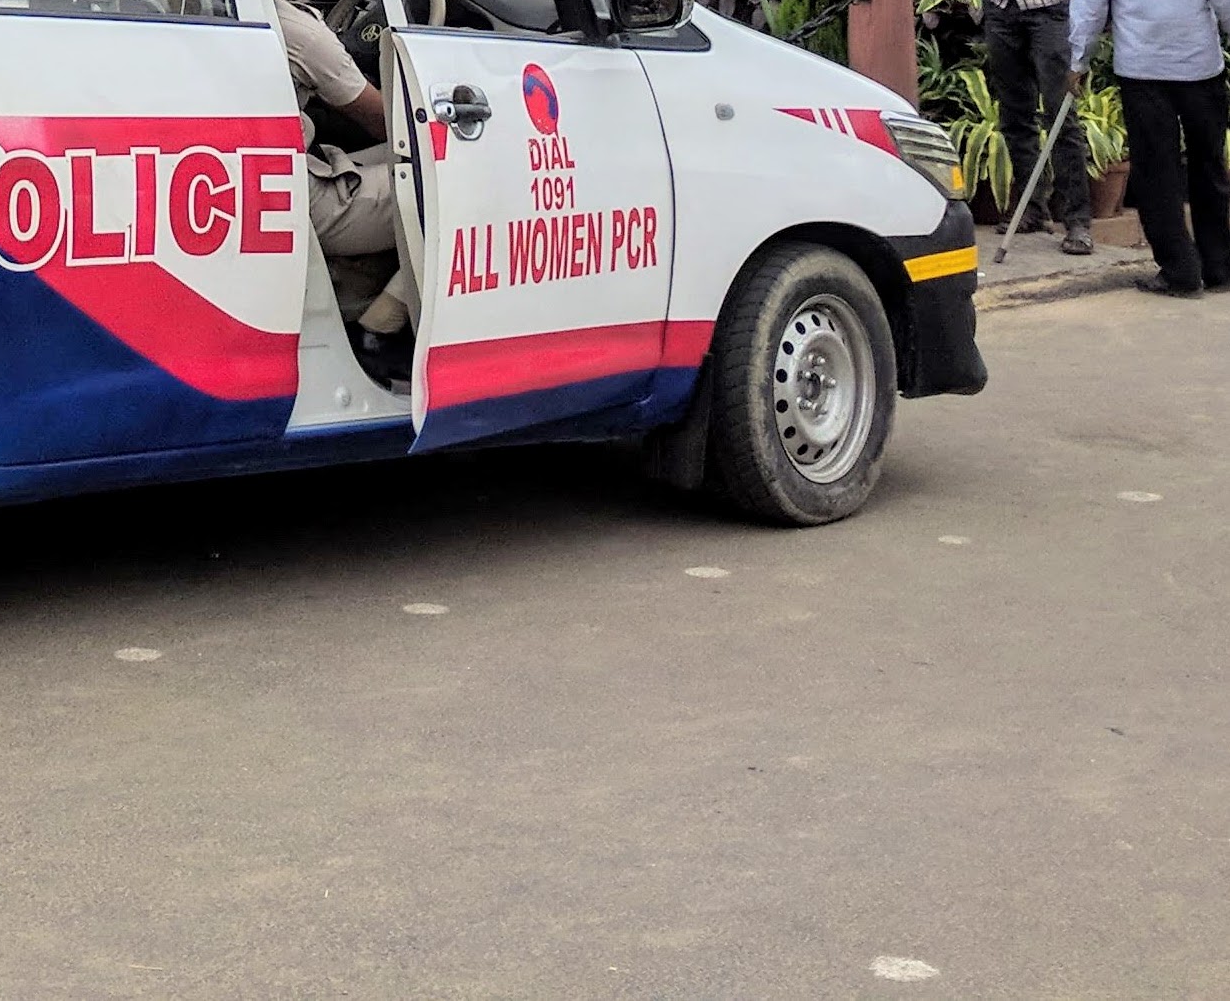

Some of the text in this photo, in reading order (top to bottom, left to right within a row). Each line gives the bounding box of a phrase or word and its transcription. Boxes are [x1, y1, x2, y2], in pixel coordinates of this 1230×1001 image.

[528, 136, 575, 172] DIAL
[530, 176, 574, 211] 1091
[447, 206, 657, 297] ALL WOMEN PCR
